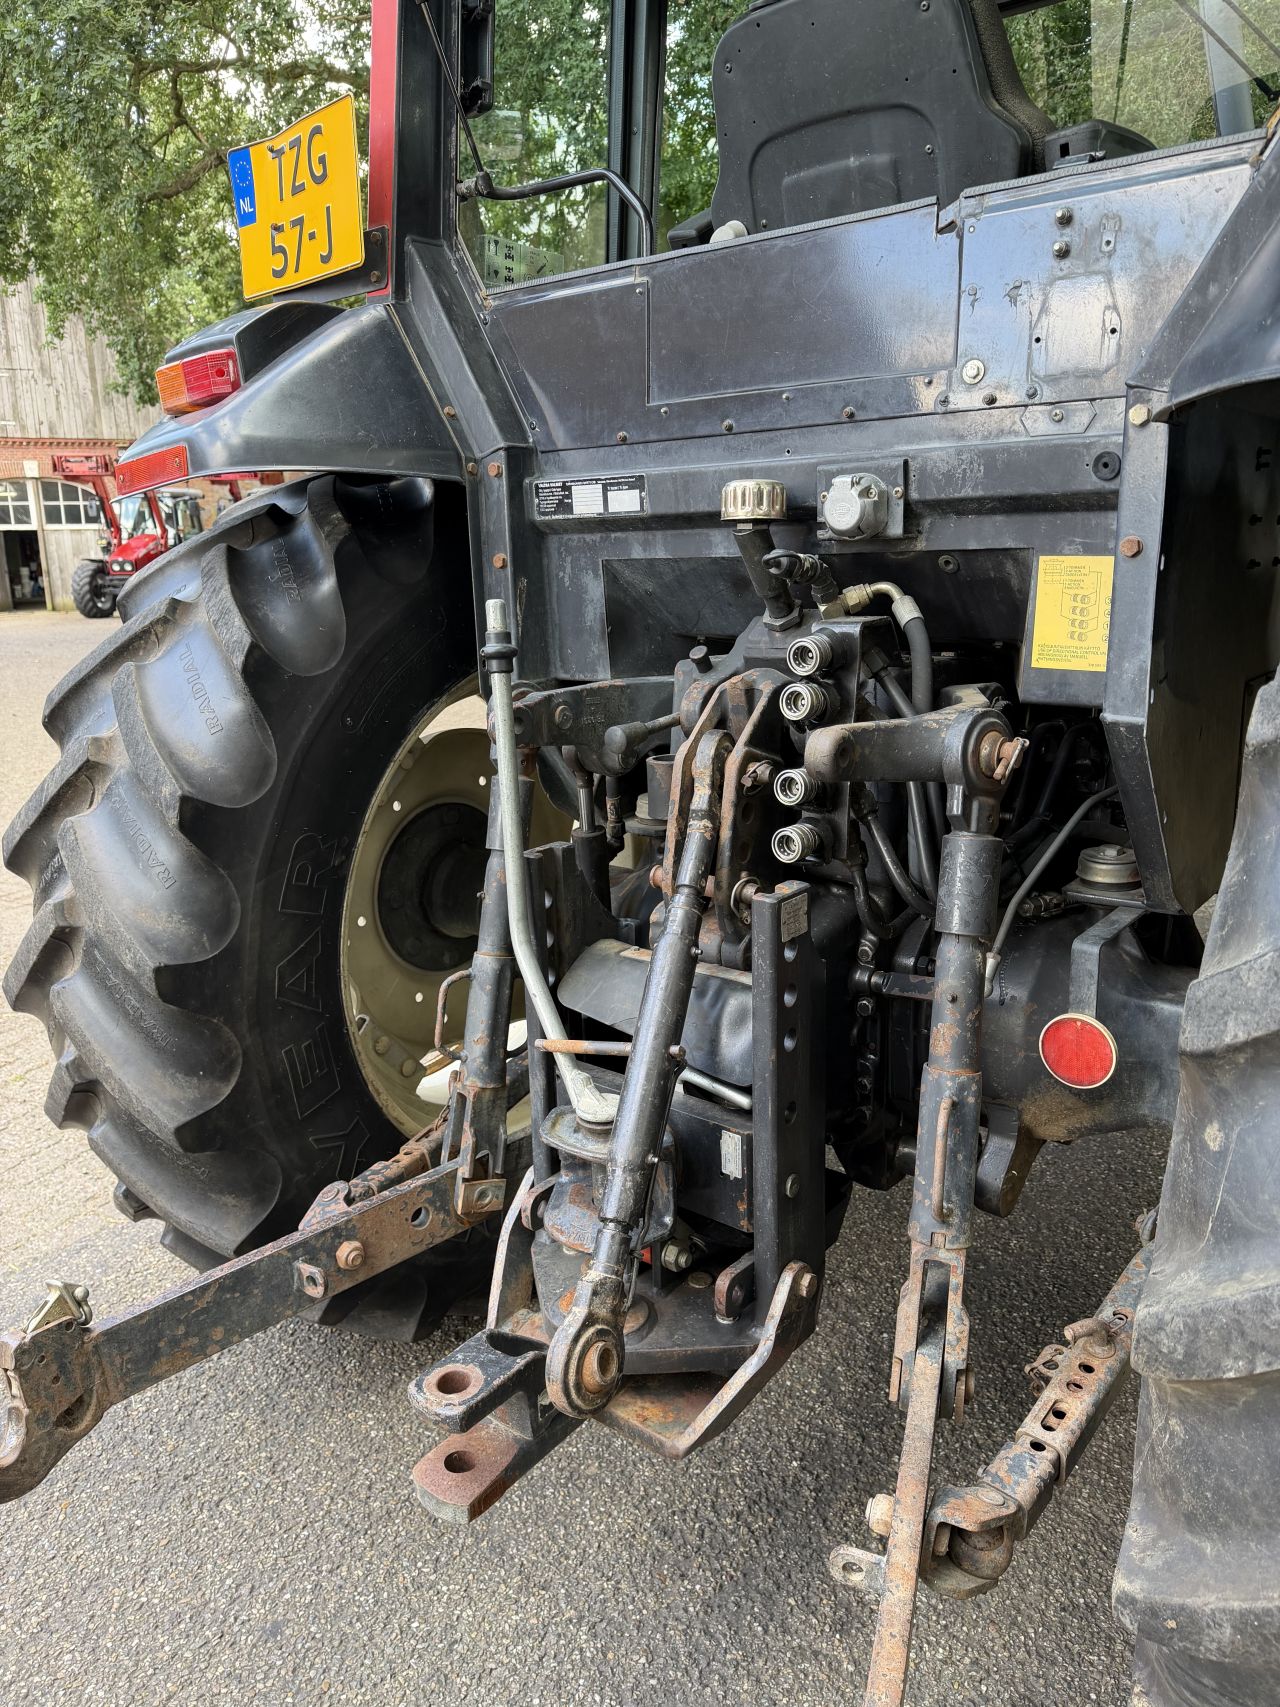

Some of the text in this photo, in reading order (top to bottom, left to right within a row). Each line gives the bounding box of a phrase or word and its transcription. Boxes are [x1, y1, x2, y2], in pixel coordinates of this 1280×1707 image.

[272, 124, 328, 201] TZG
[239, 198, 254, 215] NL
[271, 205, 333, 279] 57-J
[180, 641, 224, 736] RADIAL
[111, 785, 177, 890] RADIAL
